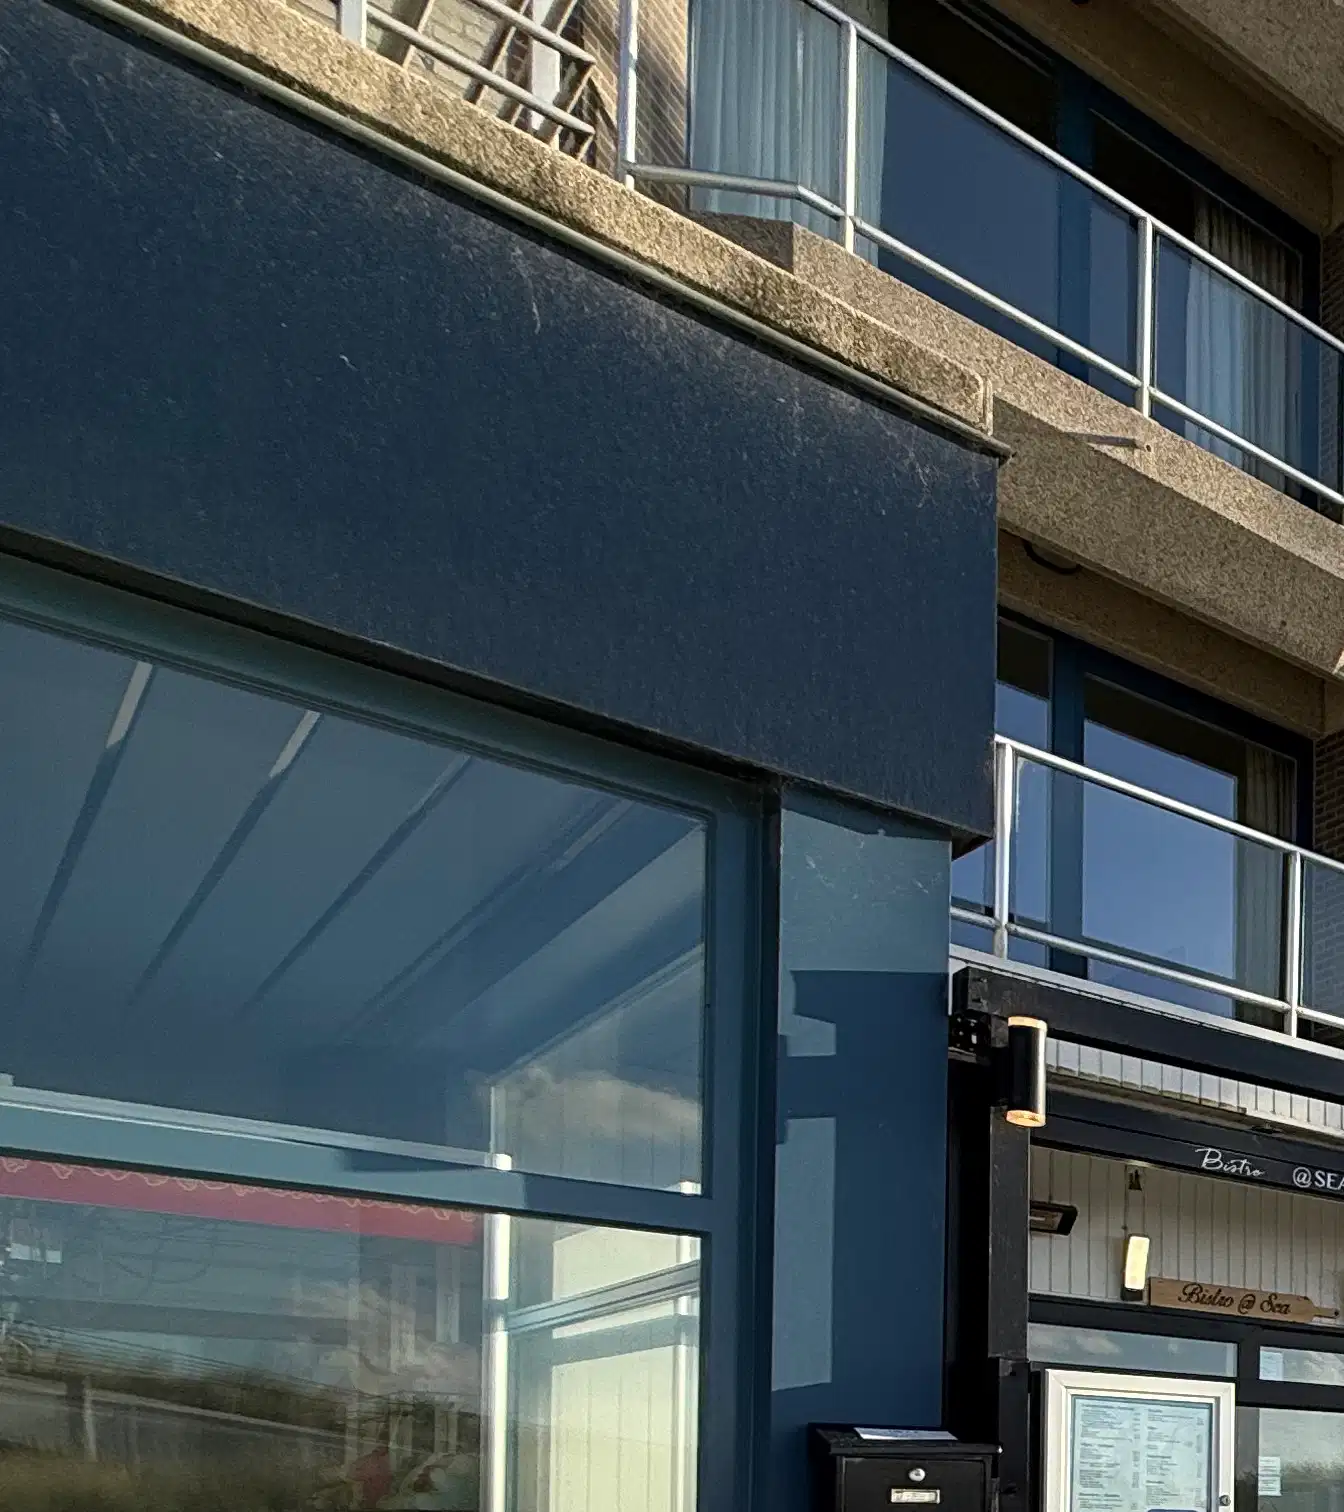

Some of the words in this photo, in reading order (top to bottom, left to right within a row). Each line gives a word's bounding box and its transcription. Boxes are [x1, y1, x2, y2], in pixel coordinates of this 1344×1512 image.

[1195, 1147, 1266, 1178] Bistro
[1178, 1282, 1234, 1308] Bistro
[1238, 1293, 1256, 1315] @
[1260, 1292, 1292, 1315] Sea
